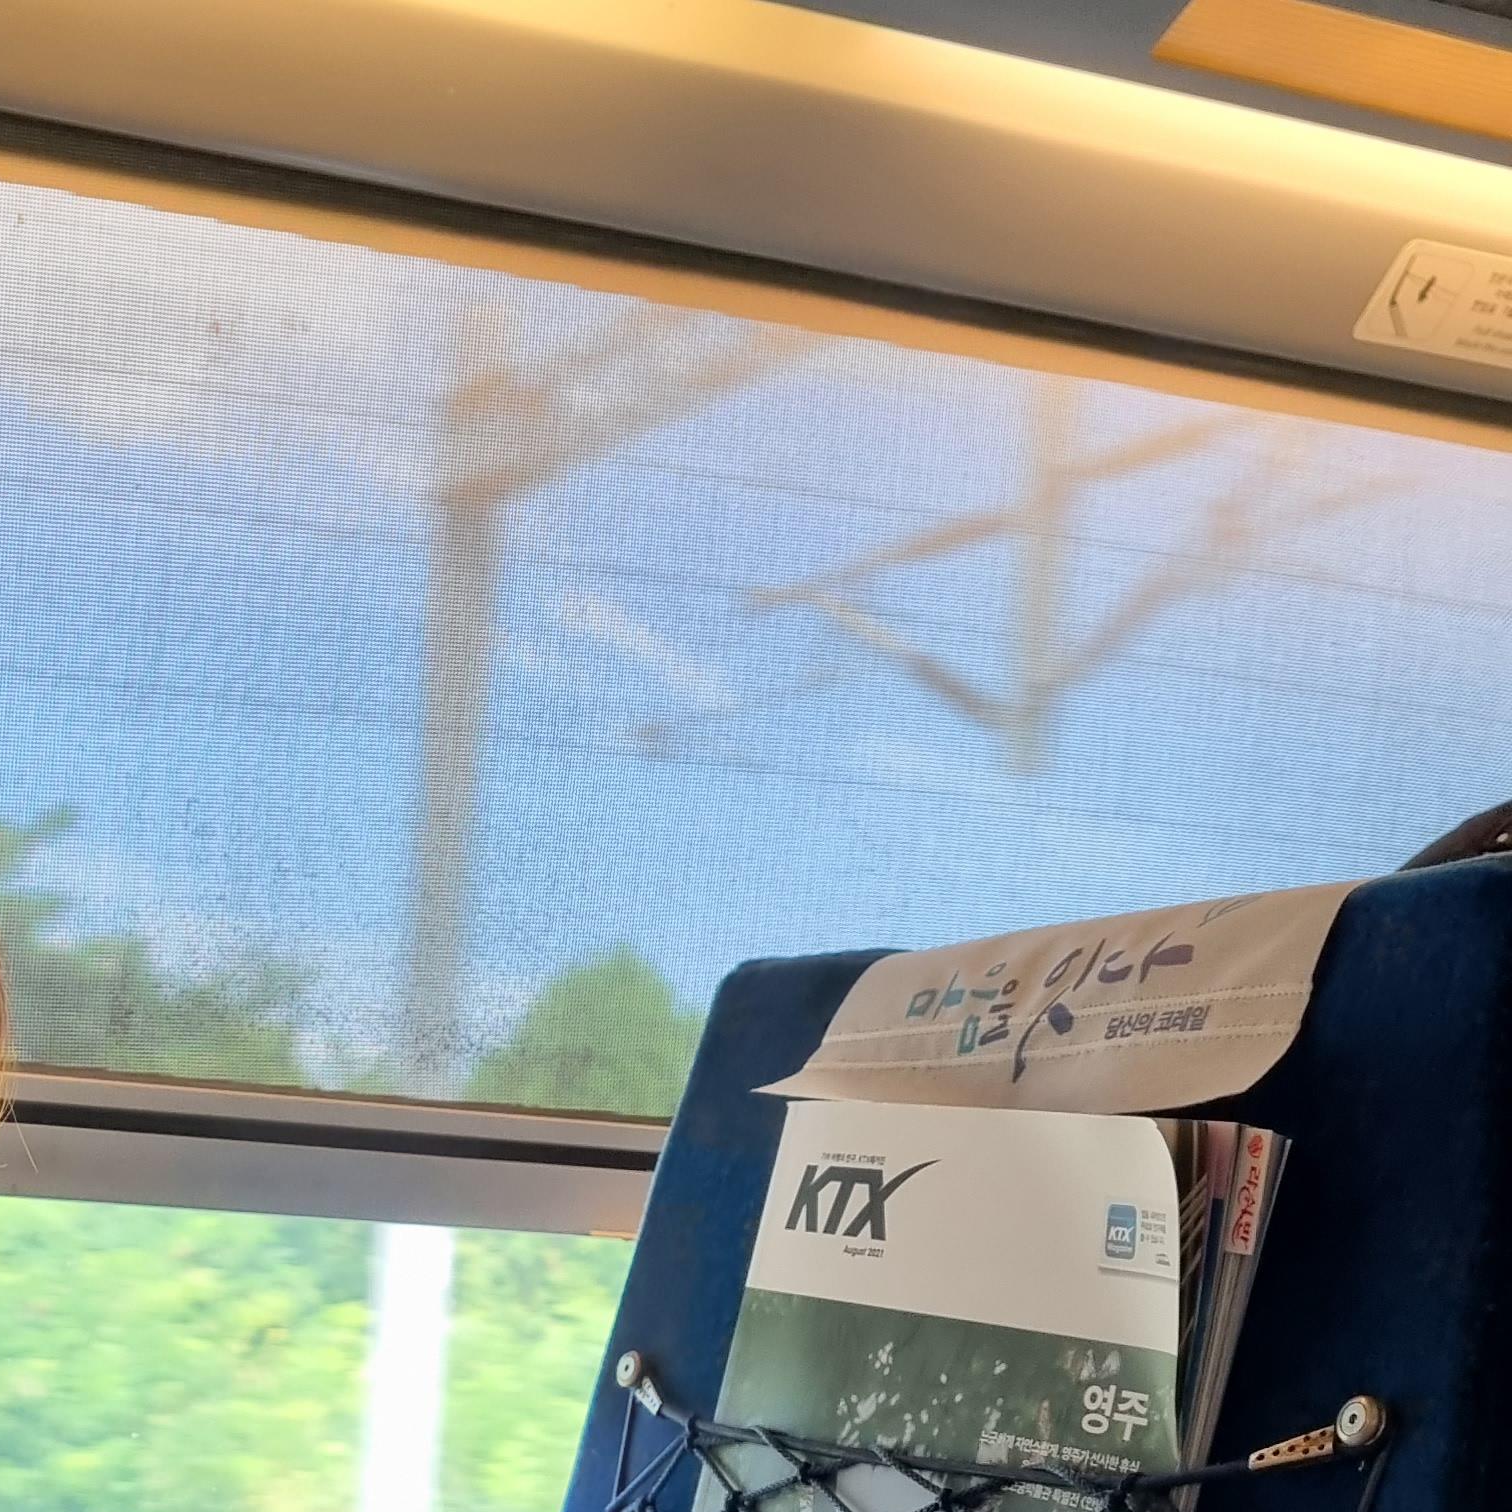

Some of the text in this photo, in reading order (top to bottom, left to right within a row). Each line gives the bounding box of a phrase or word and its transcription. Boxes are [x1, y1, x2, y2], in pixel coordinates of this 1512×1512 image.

[1104, 1006, 1211, 1040] 당신의 코레일
[785, 1159, 942, 1241] KTX
[1108, 1226, 1135, 1242] KTX
[843, 1245, 867, 1257] August
[1081, 1384, 1150, 1442] 영주
[1061, 1447, 1089, 1465] 영주가
[1090, 1452, 1119, 1471] 선사한
[1119, 1457, 1141, 1474] 휴식
